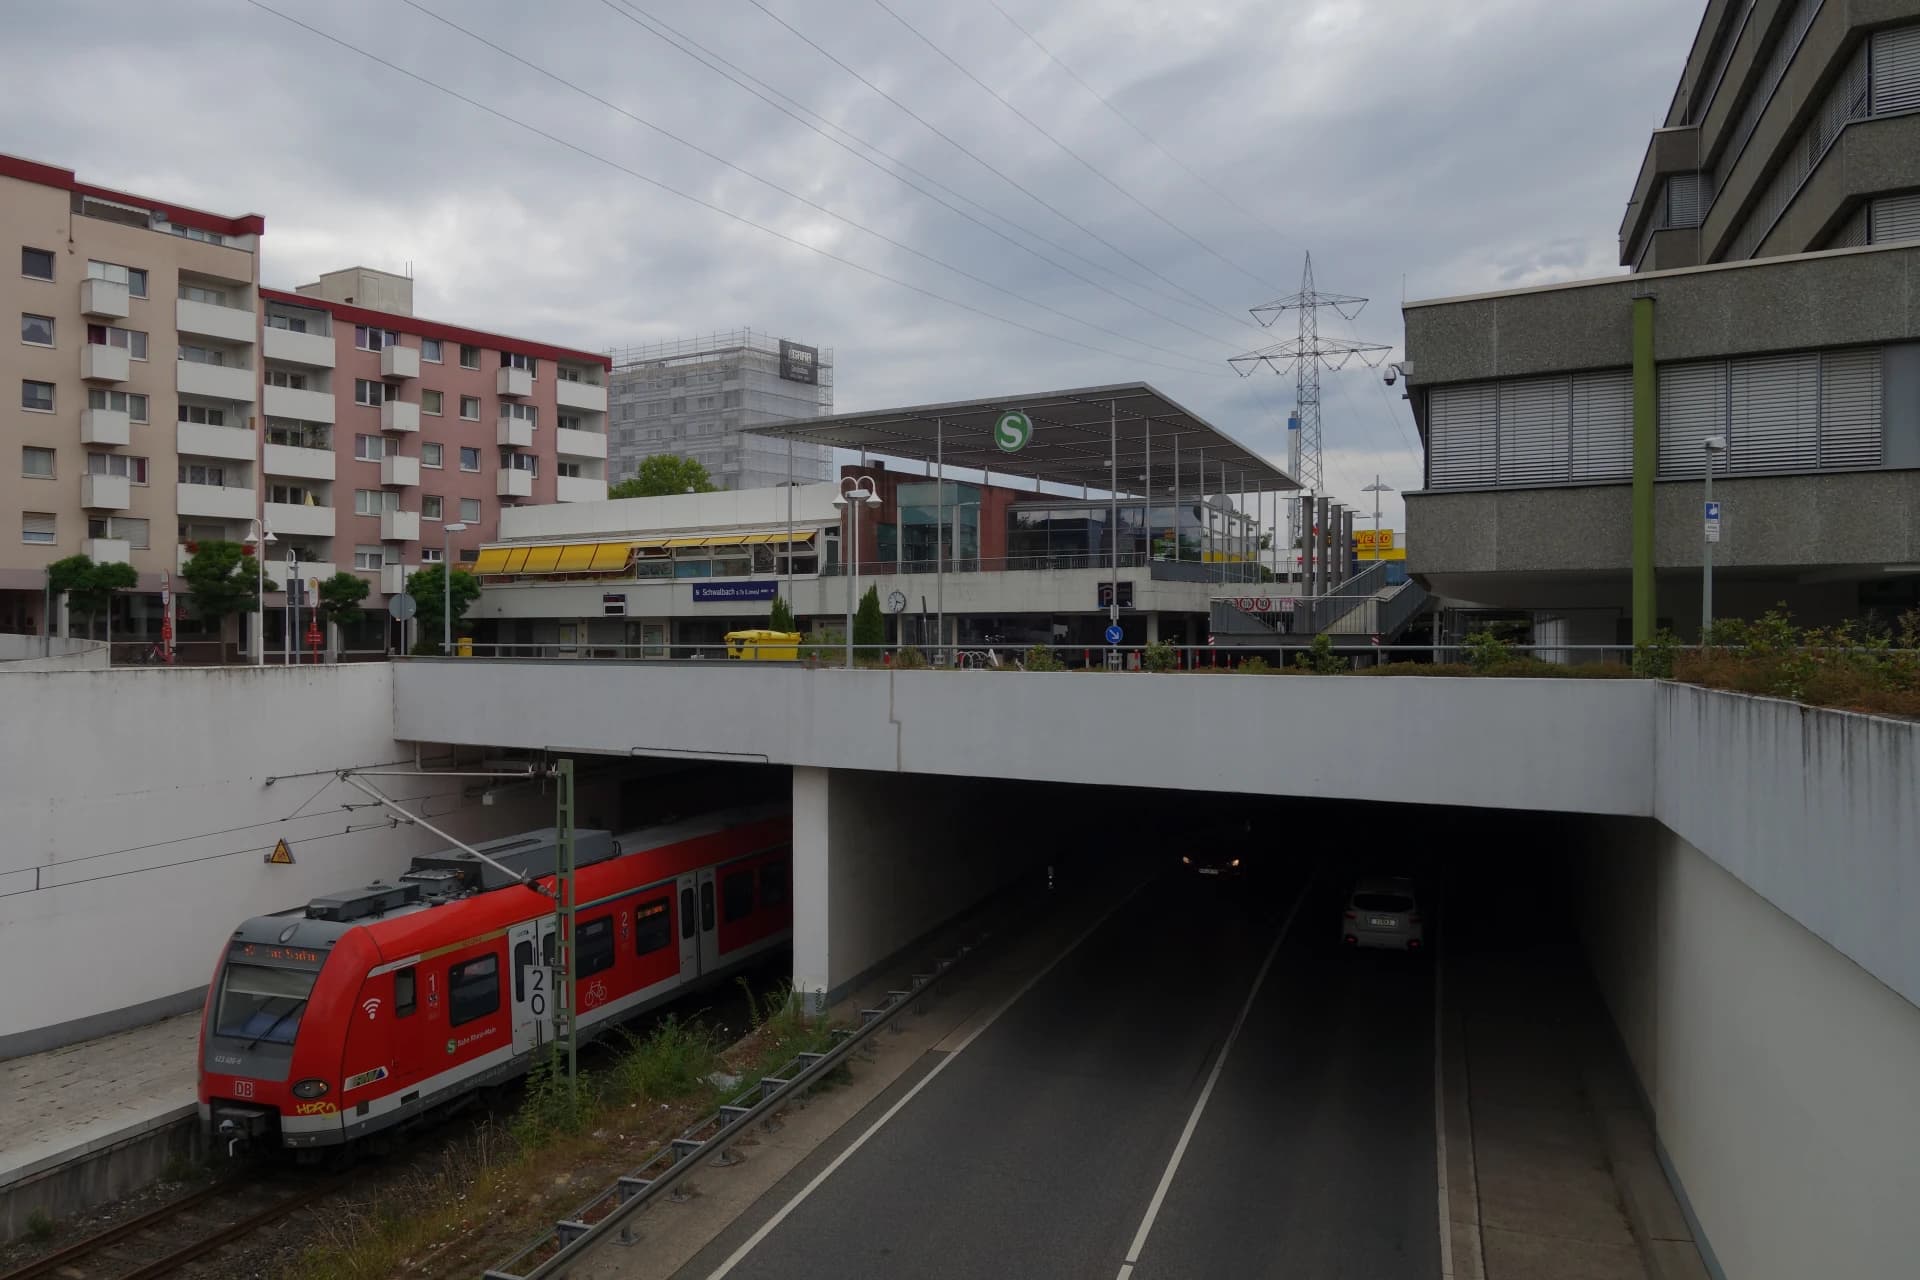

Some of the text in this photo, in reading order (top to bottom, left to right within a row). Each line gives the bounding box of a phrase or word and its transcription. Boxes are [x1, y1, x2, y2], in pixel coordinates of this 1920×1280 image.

[1001, 415, 1023, 448] S
[1104, 590, 1113, 606] P
[621, 912, 628, 927] 2
[428, 973, 435, 992] 1
[447, 1039, 456, 1054] S
[236, 1082, 253, 1096] DB
